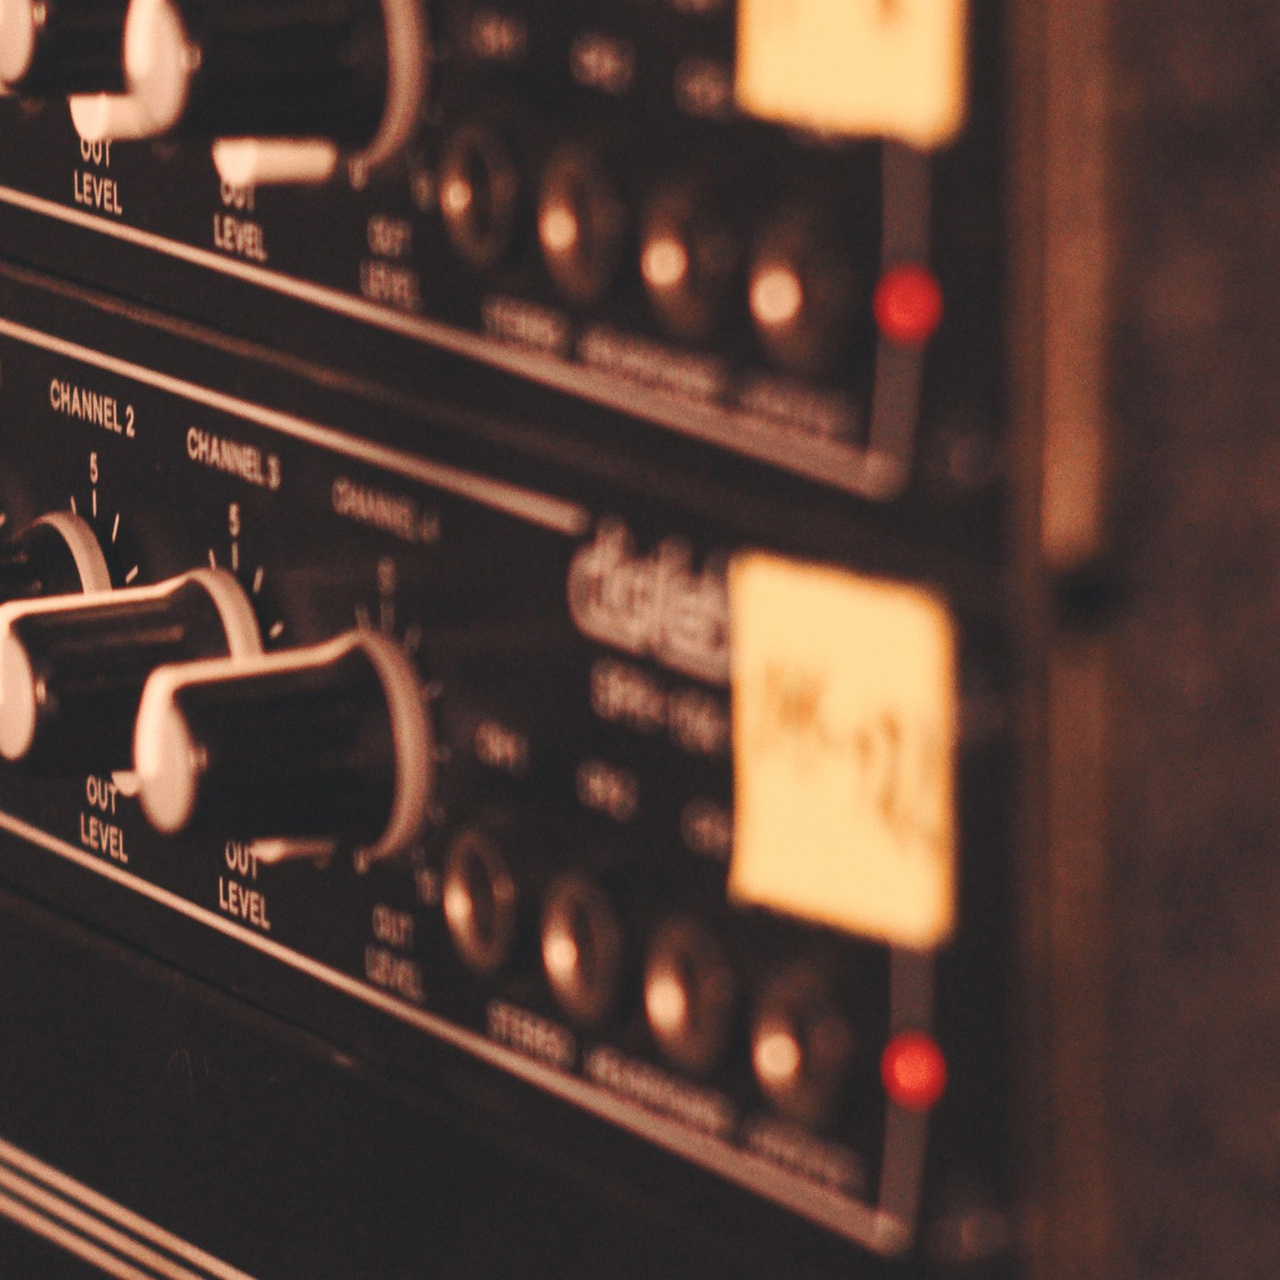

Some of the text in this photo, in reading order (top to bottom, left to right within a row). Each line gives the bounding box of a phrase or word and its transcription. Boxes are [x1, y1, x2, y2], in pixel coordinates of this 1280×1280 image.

[73, 168, 124, 215] LEVEL
[212, 211, 268, 263] LEVEL
[49, 377, 136, 439] CHANNEL 2
[89, 450, 99, 484] 5
[186, 425, 267, 488] CHANNEL
[86, 773, 118, 815] OUT
[80, 810, 129, 864] LEVEL
[225, 839, 259, 881] OUT
[218, 875, 272, 932] LEVEL
